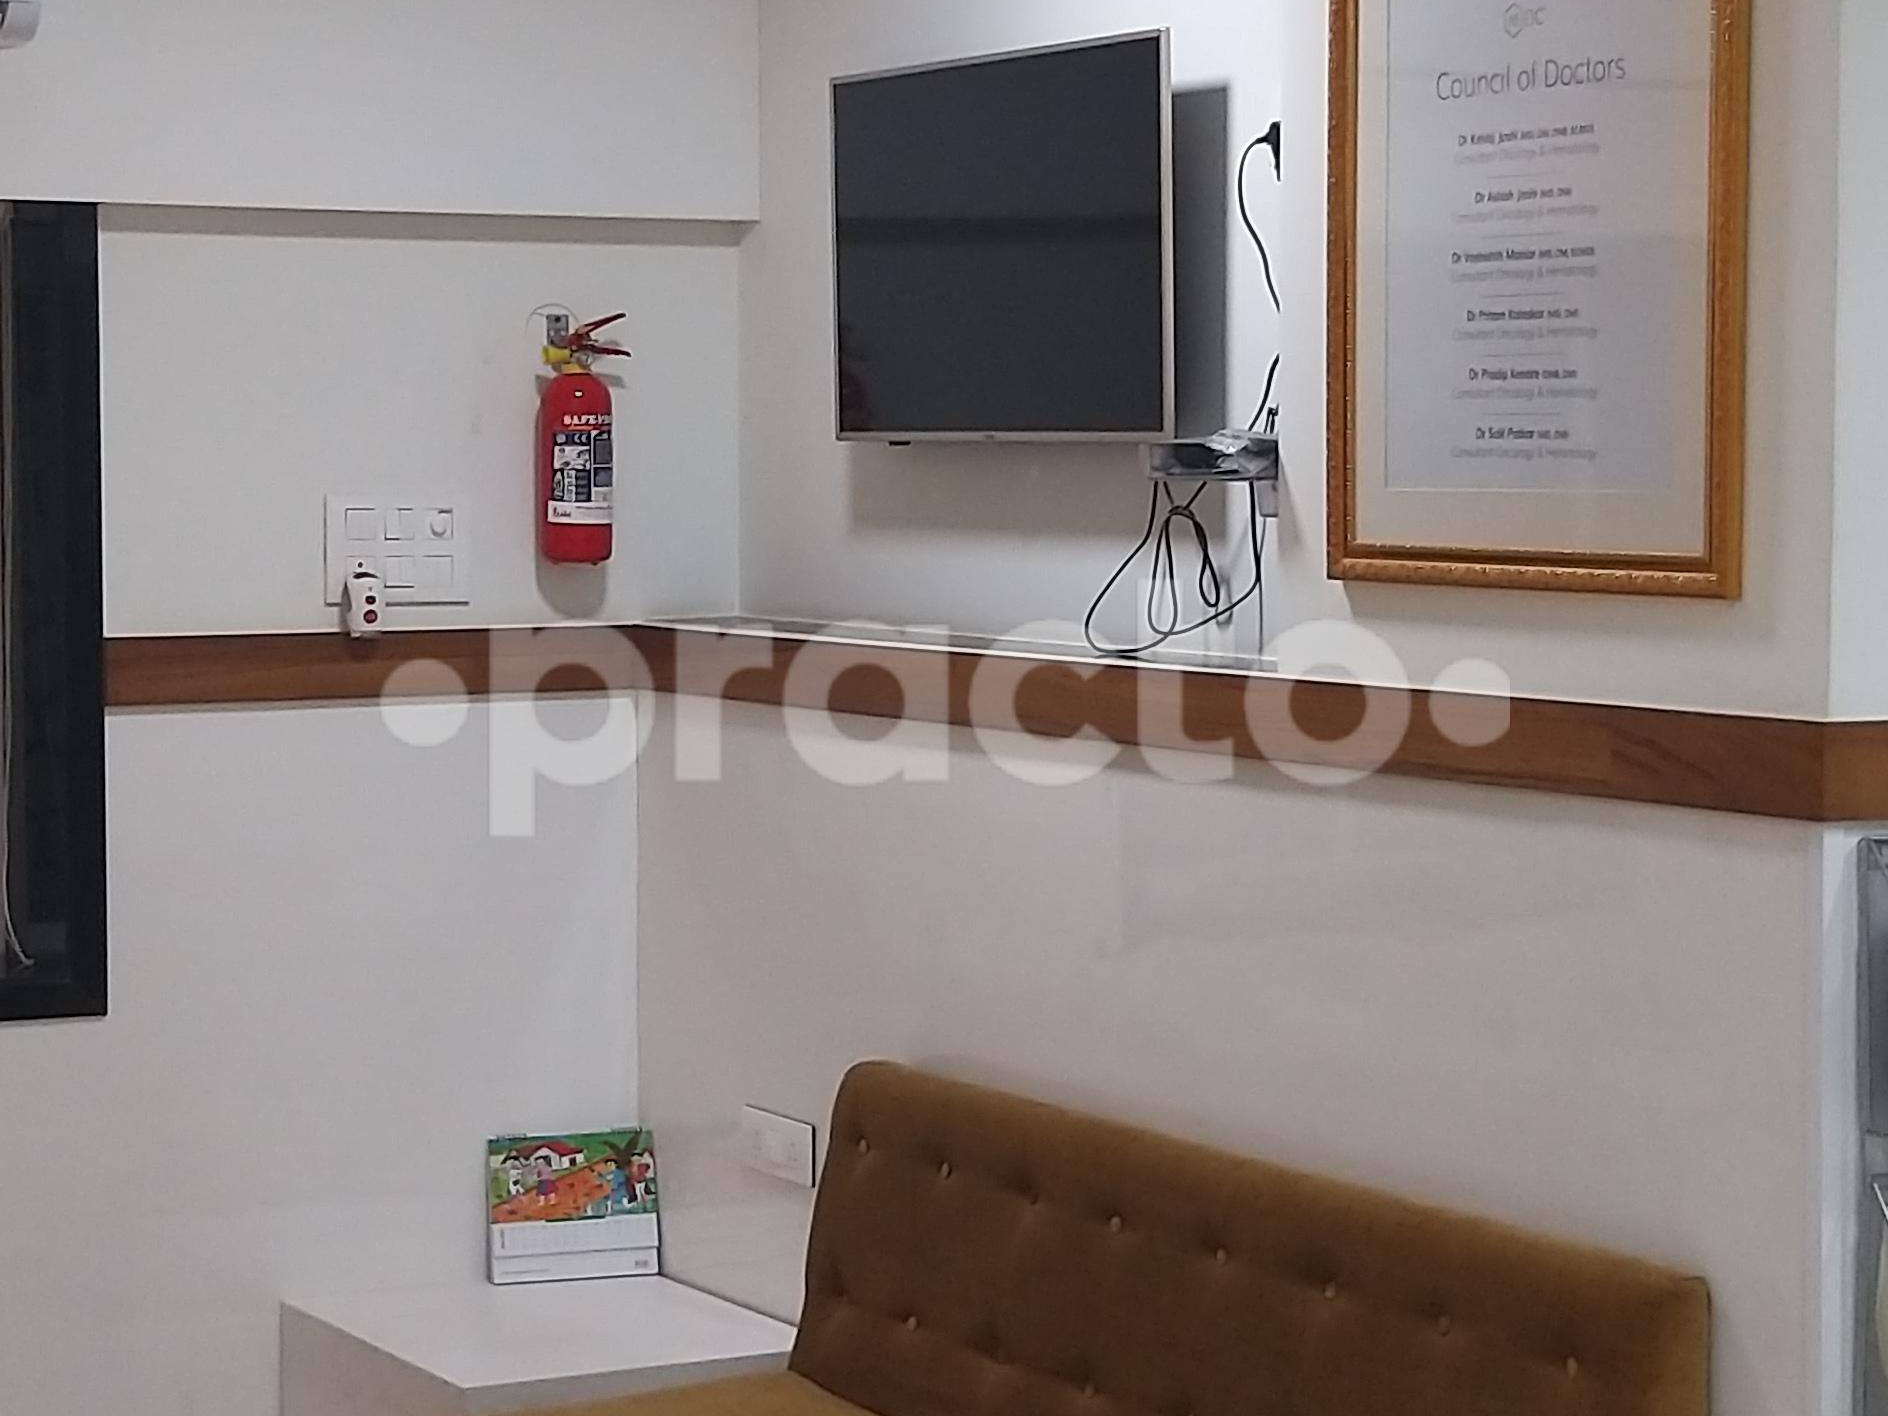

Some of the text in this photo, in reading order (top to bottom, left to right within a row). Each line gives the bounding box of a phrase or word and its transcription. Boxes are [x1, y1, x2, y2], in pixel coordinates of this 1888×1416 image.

[1437, 57, 1627, 100] Council of Doctors
